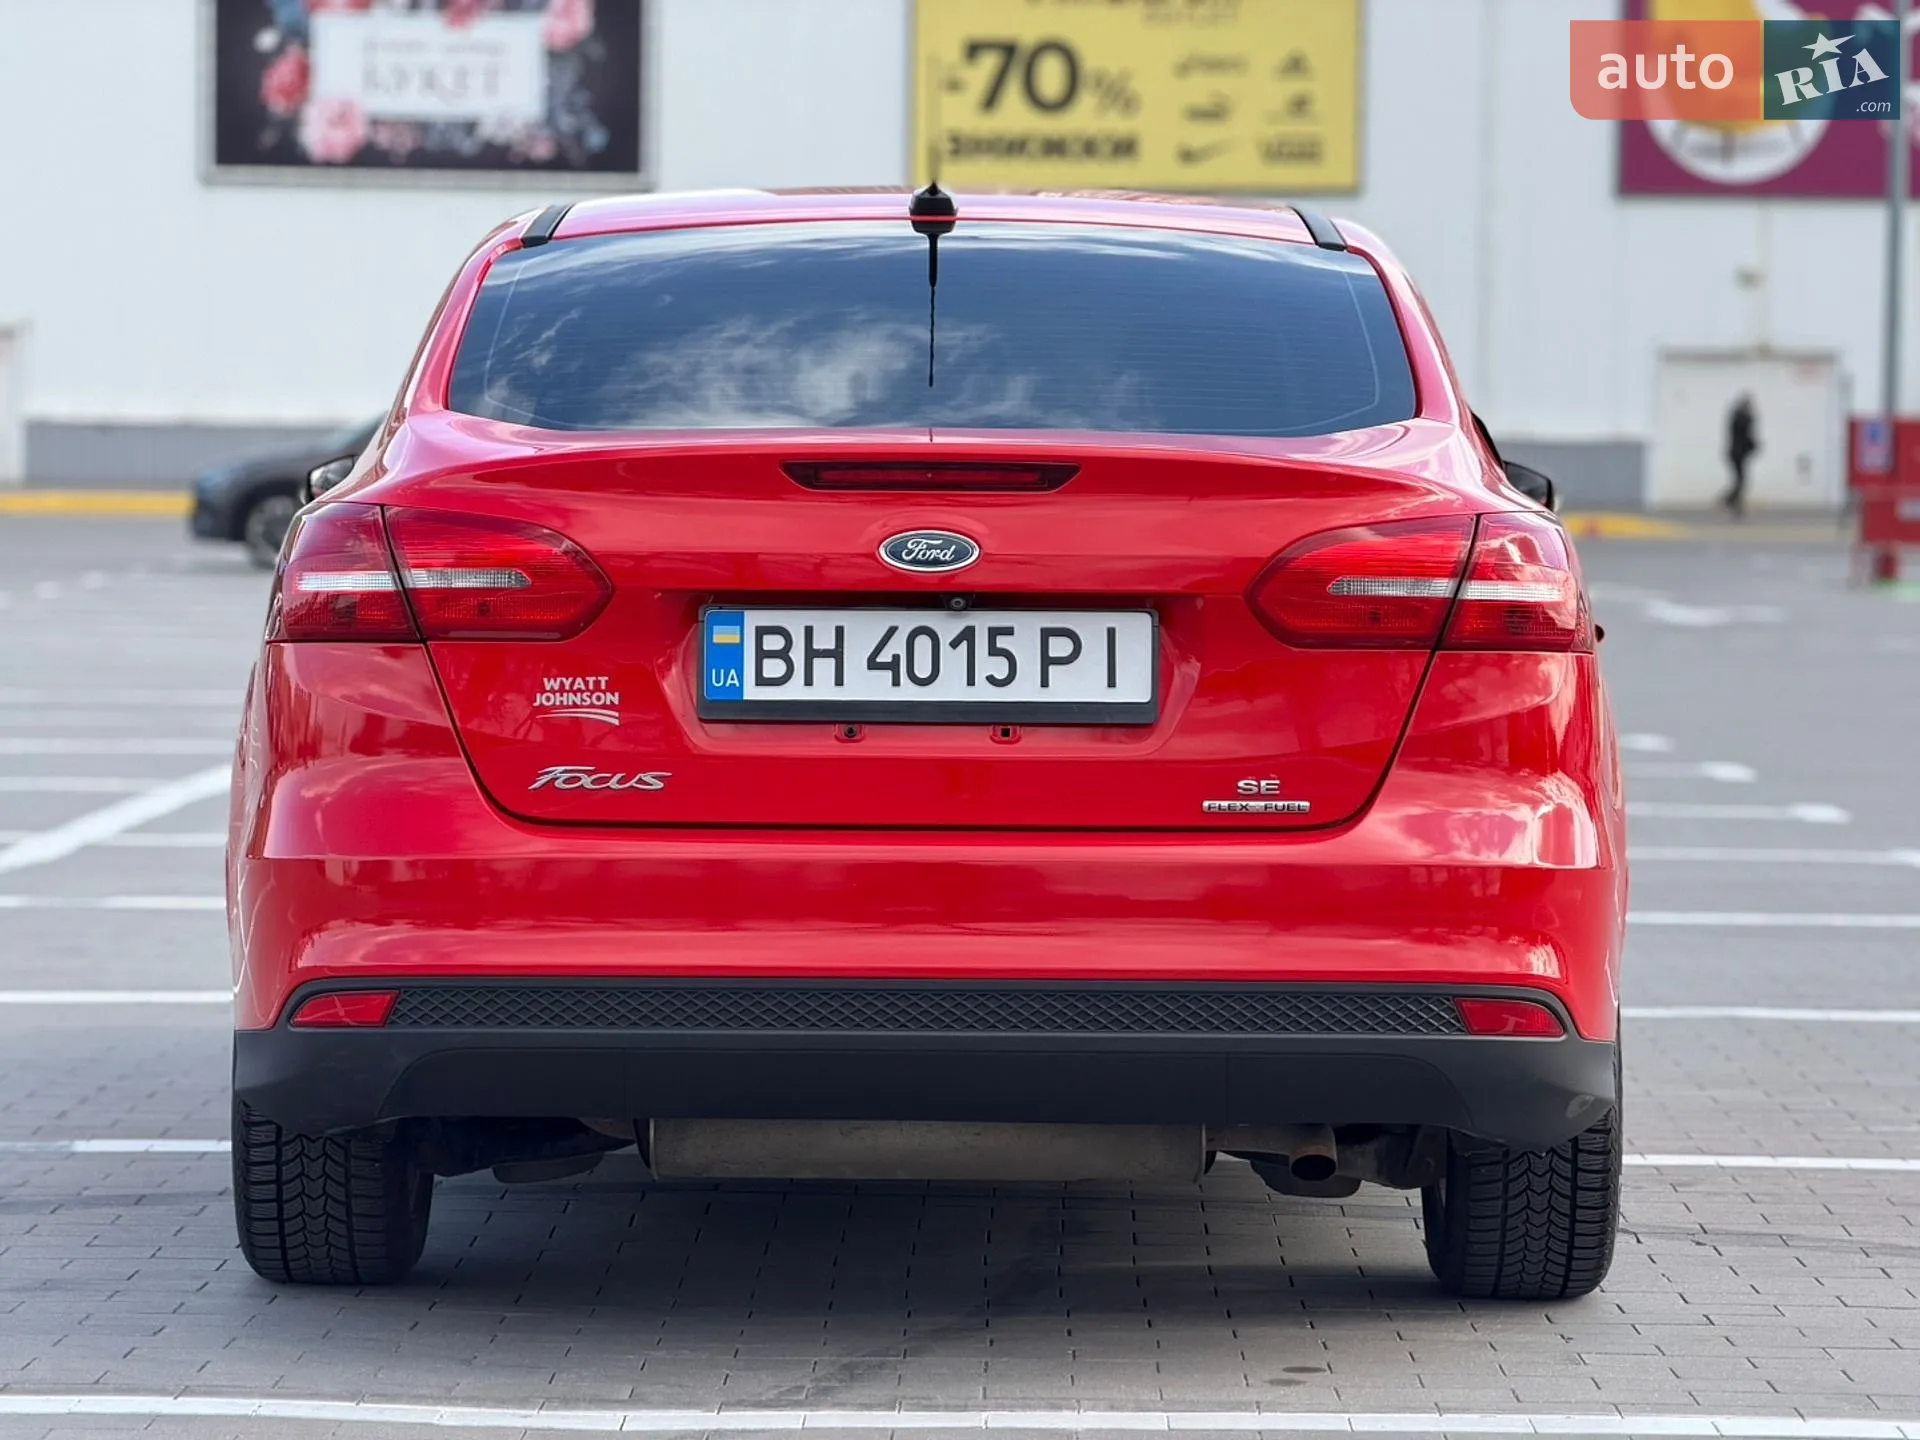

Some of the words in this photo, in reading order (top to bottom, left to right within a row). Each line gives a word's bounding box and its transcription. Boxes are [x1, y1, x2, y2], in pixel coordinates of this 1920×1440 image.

[901, 538, 956, 561] Ford
[754, 625, 845, 687] BH
[866, 625, 1018, 688] 4015
[542, 676, 609, 691] WYATT
[711, 670, 740, 688] UA
[533, 691, 620, 707] JOHNSON
[1236, 779, 1281, 795] SE
[1206, 802, 1250, 812] FLEX
[1263, 802, 1308, 812] FUEL
